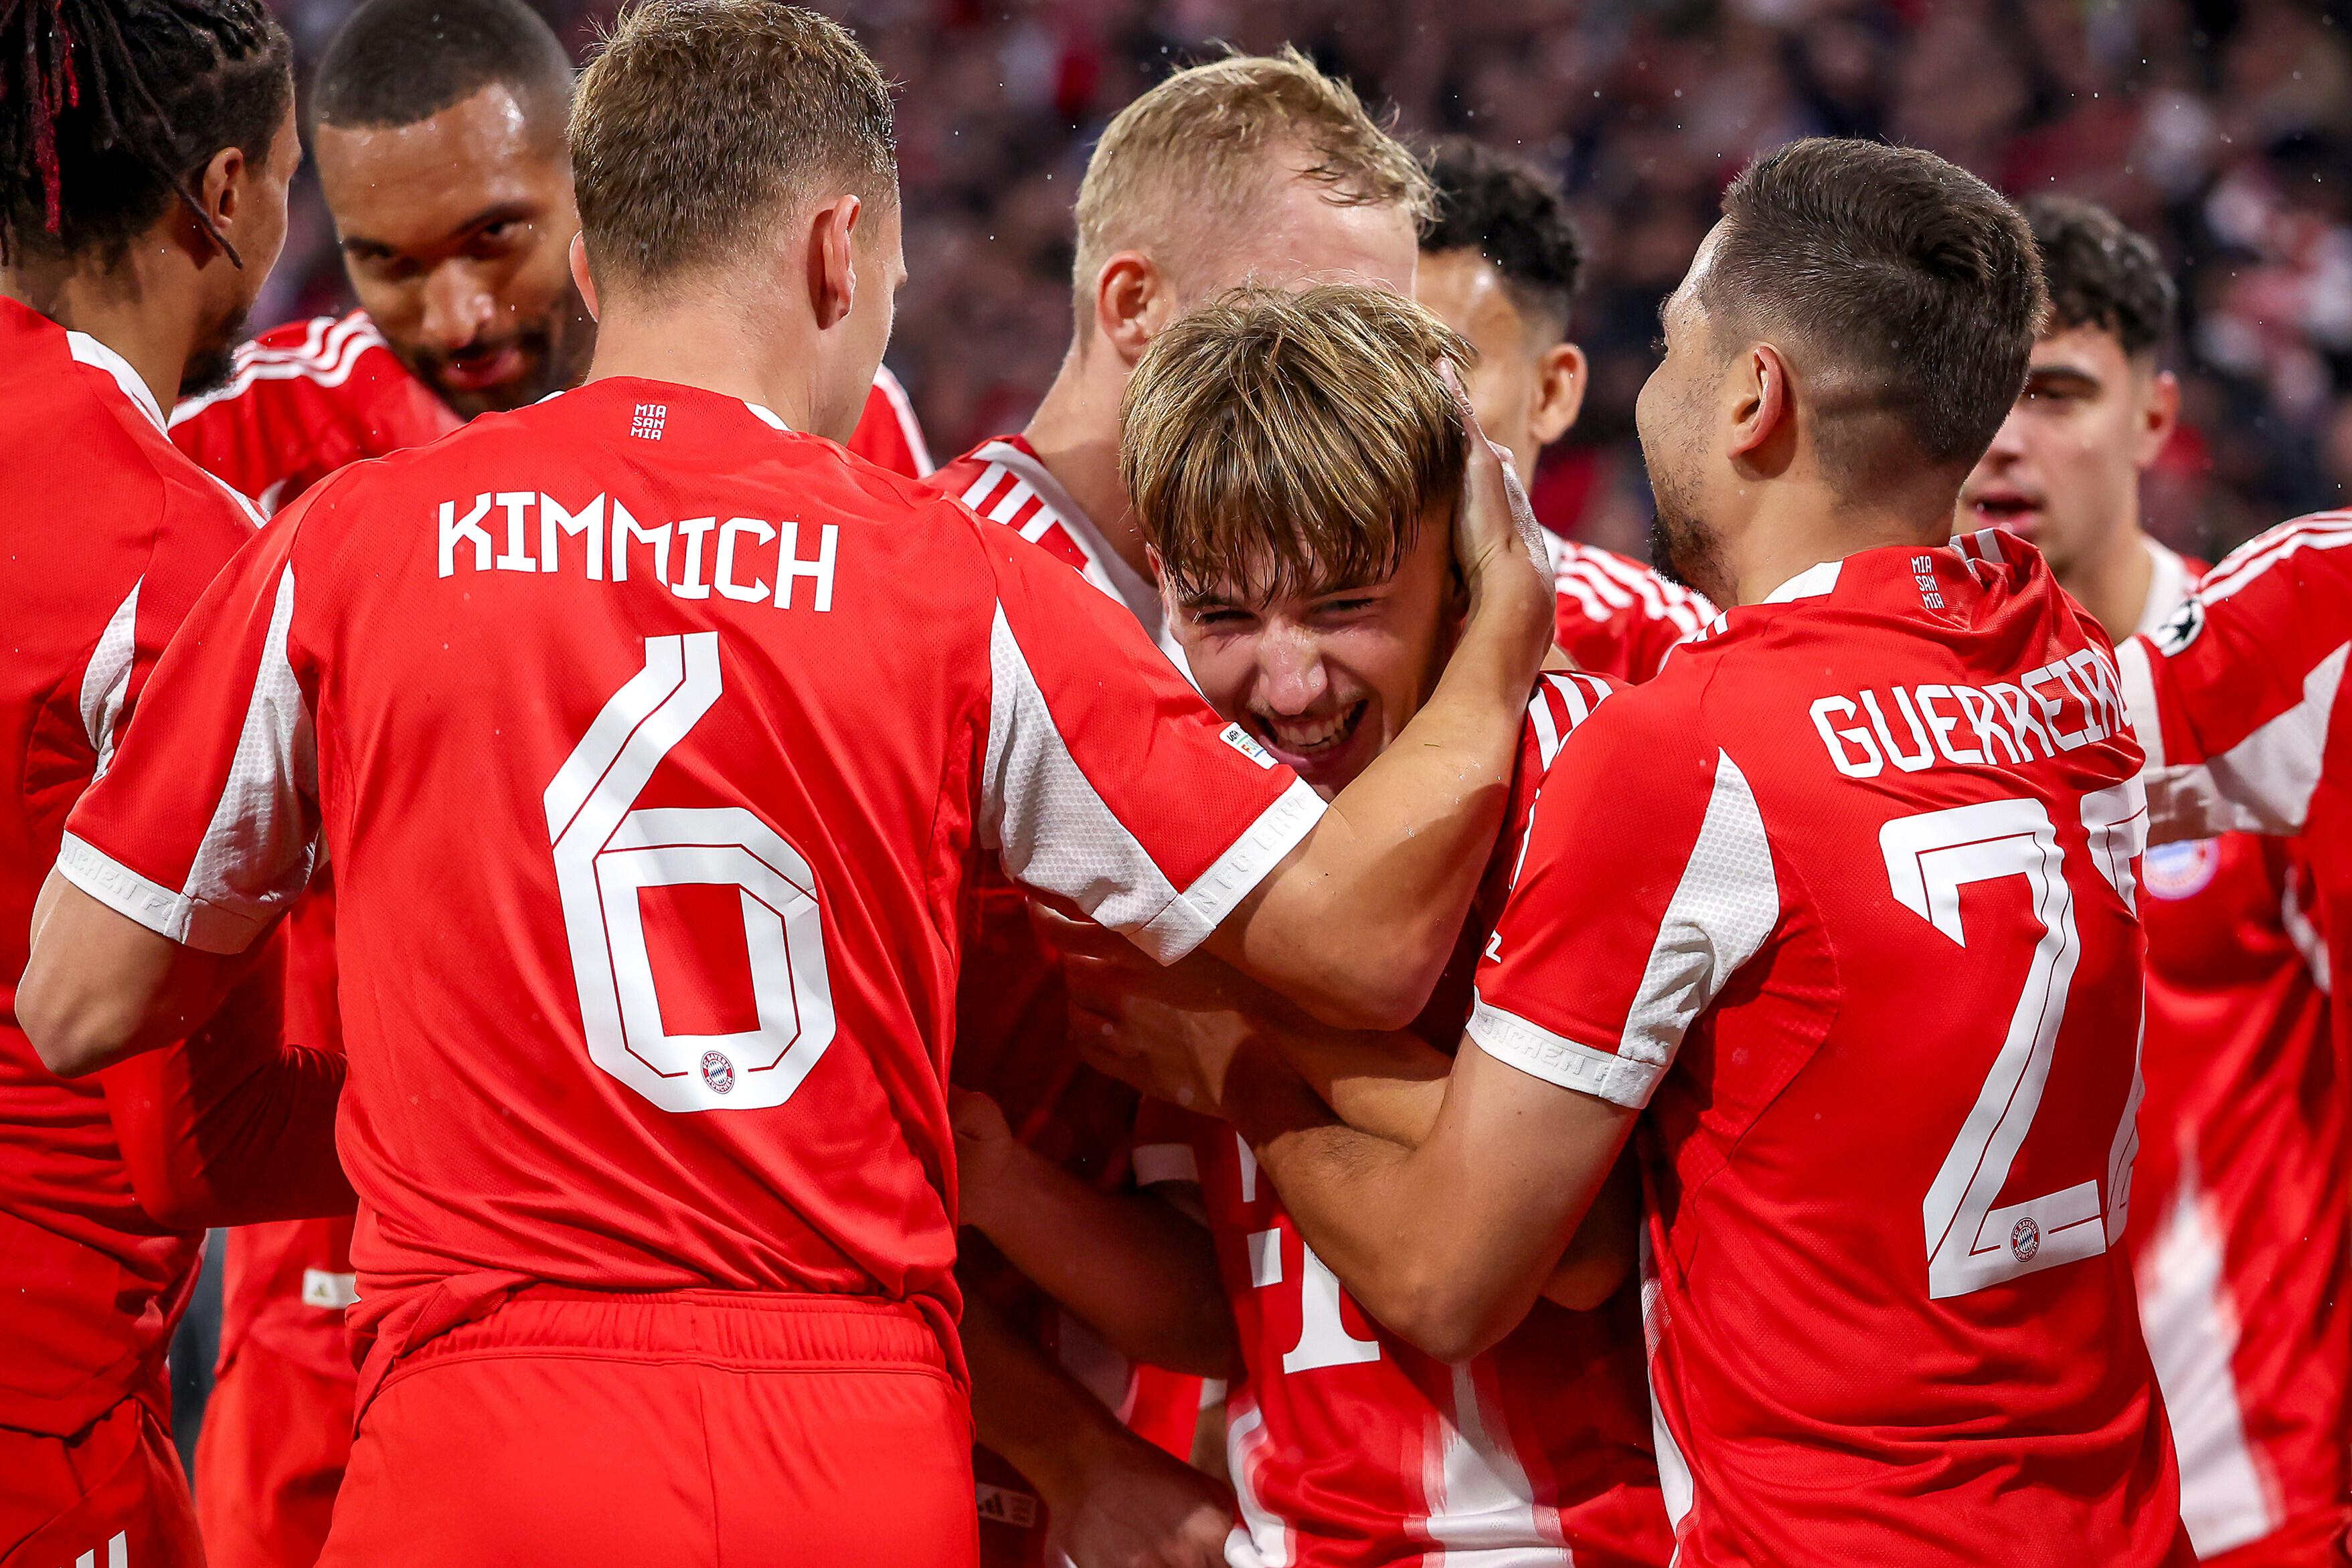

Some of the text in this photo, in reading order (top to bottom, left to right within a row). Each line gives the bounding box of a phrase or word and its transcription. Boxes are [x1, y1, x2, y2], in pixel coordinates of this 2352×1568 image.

[635, 403, 667, 418] MIA
[632, 416, 665, 429] SAN
[630, 426, 663, 441] MIA
[437, 491, 840, 613] KIMMICH
[1910, 555, 1932, 574] MIA
[1914, 574, 1938, 592] SAN
[1921, 592, 1945, 609] MIA
[543, 630, 837, 1114] 6
[707, 1053, 731, 1070] BAYERN
[2018, 1221, 2037, 1234] BAYERN
